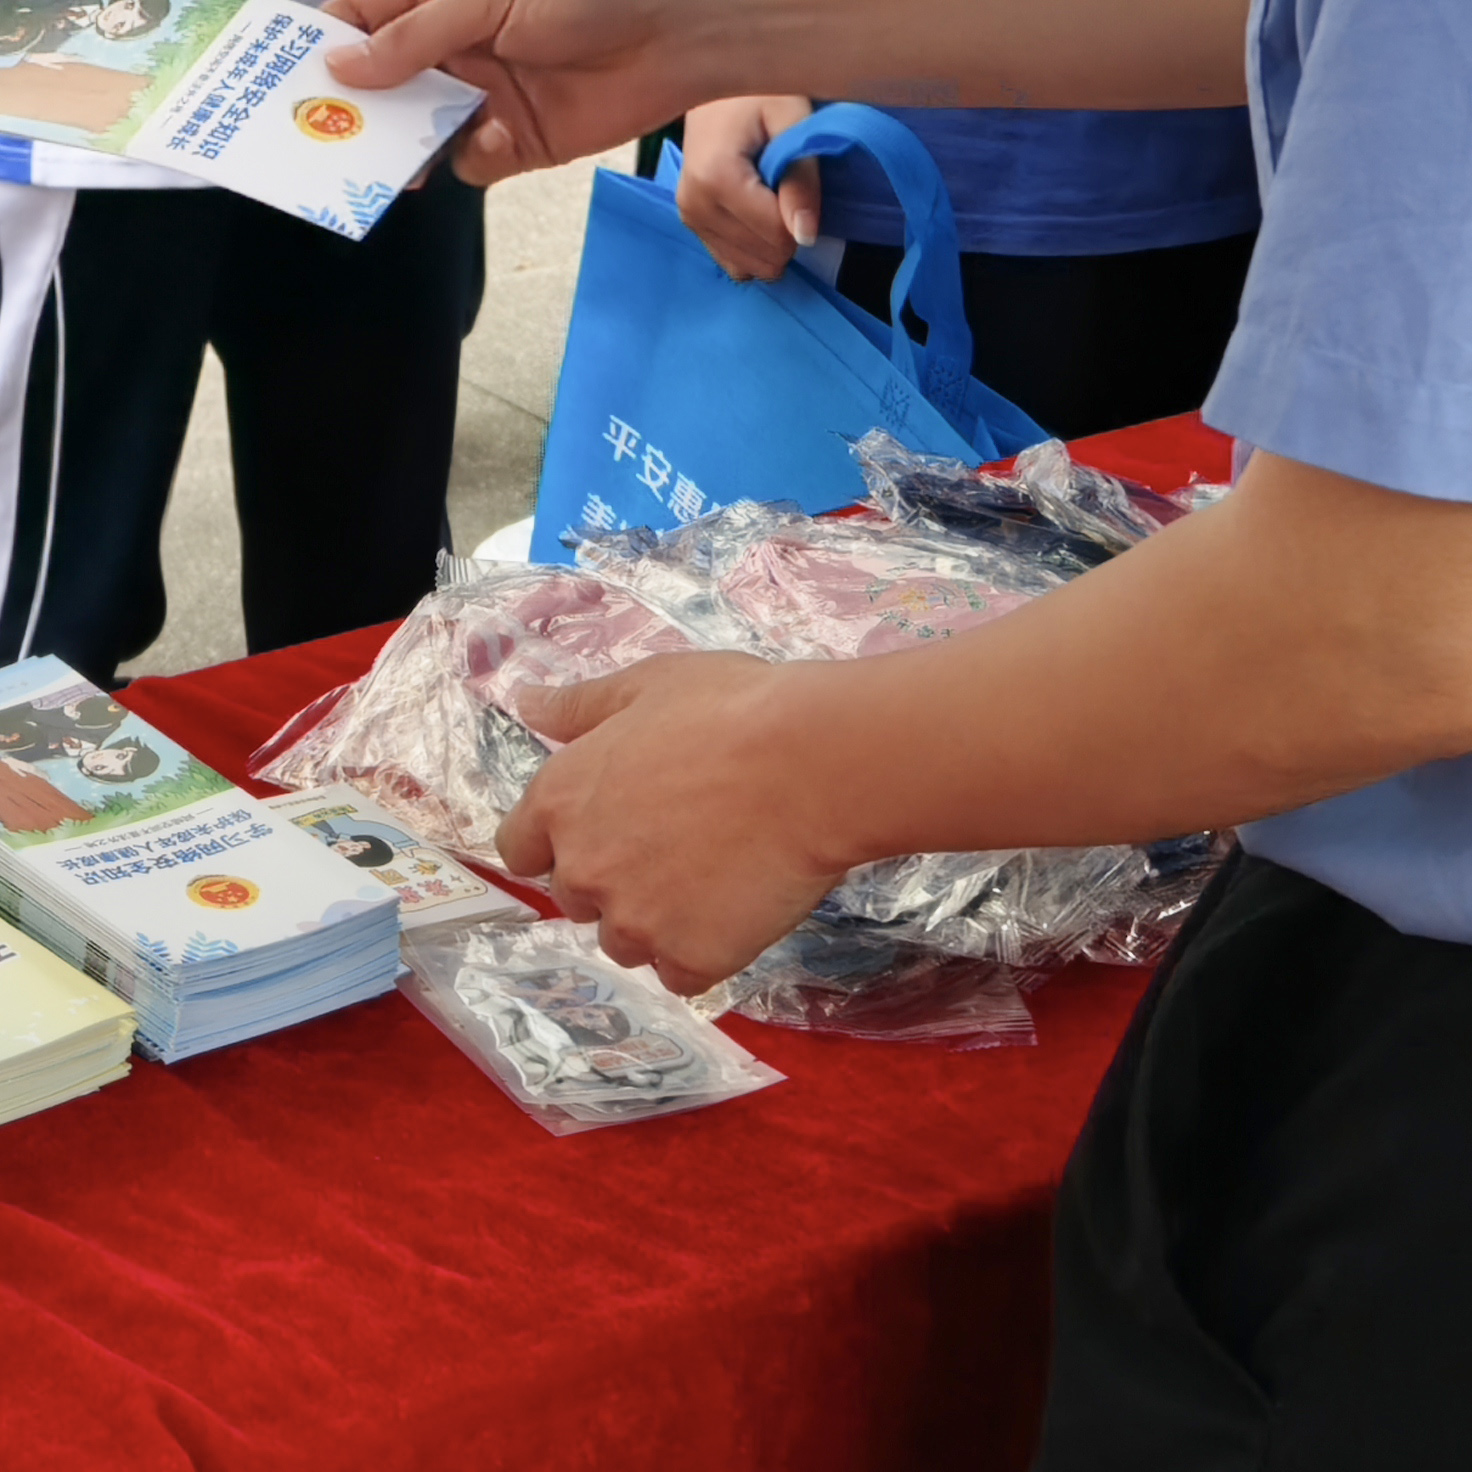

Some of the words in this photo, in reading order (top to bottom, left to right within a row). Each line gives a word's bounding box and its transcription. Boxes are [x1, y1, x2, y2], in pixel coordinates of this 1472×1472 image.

[191, 21, 325, 161] 学习网络安全知识
[602, 414, 720, 524] 平安惠
[81, 824, 273, 888] 学习网络安全知识
